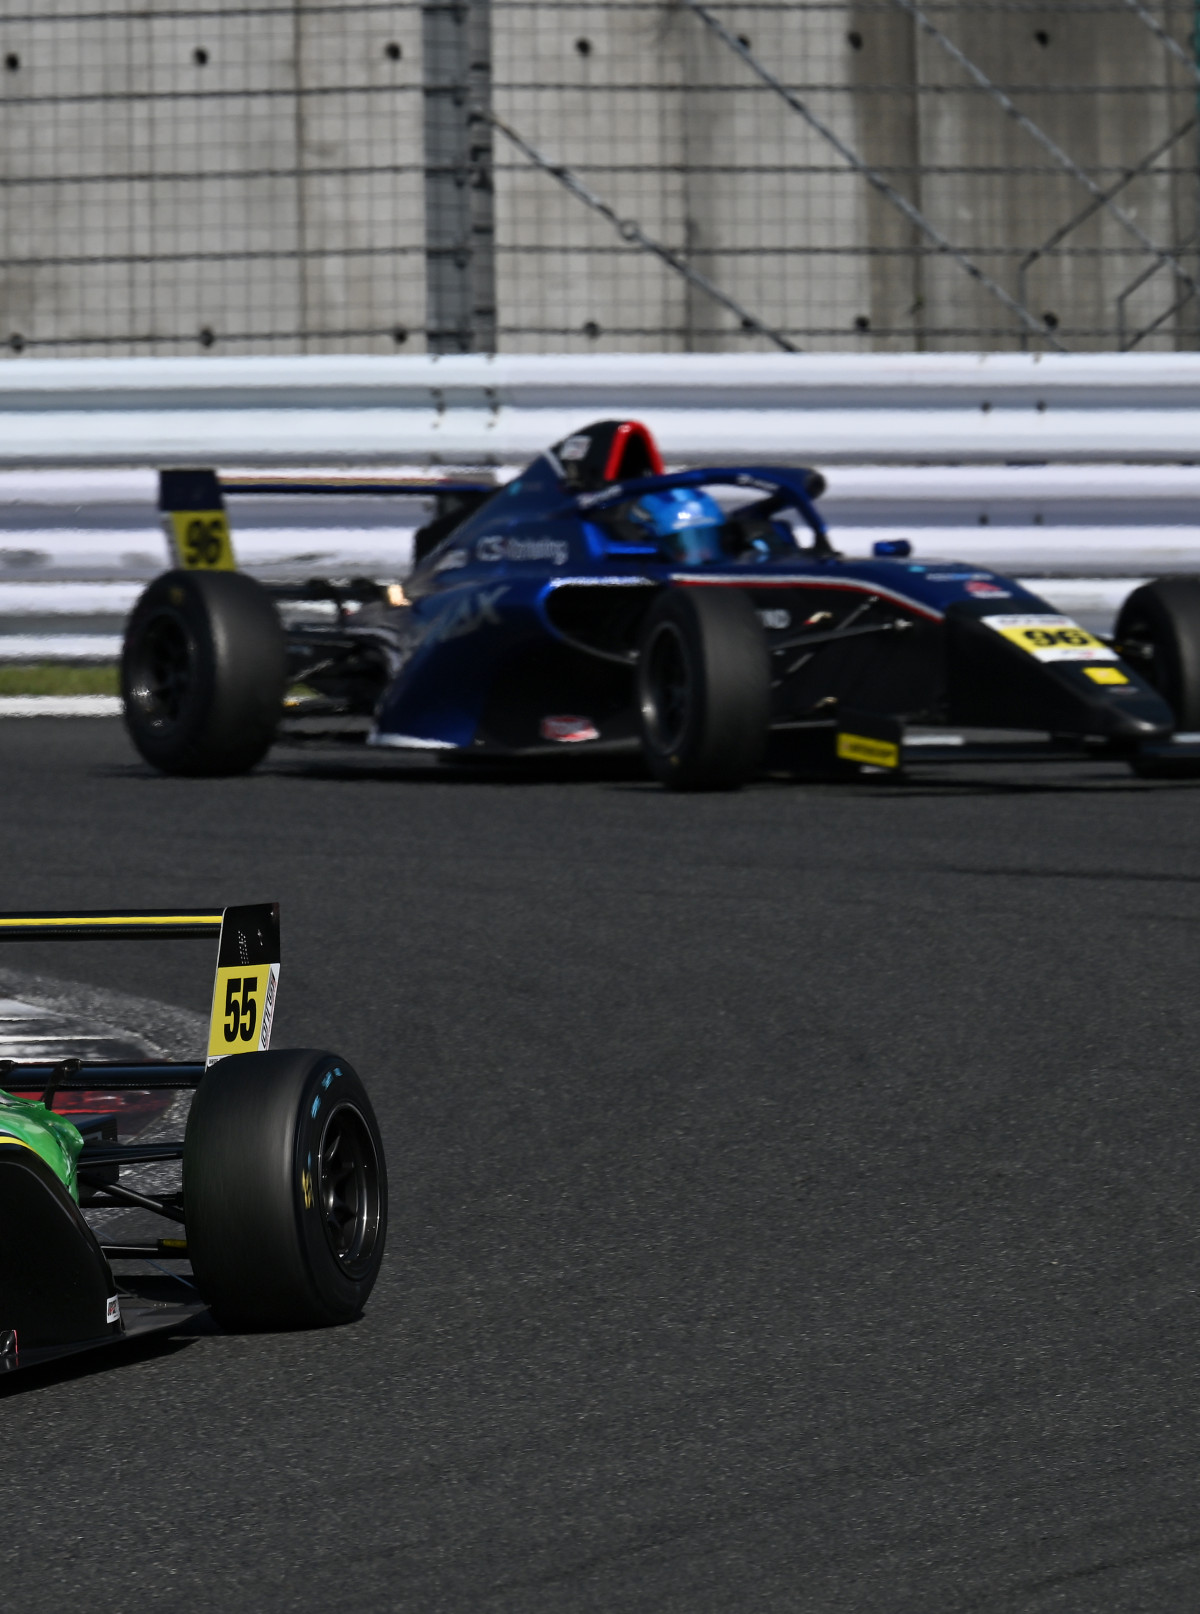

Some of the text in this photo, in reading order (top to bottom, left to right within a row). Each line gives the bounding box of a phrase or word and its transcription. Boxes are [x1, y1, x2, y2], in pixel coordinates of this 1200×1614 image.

[185, 518, 224, 567] 96
[1023, 628, 1089, 647] 96
[224, 977, 257, 1042] 55
